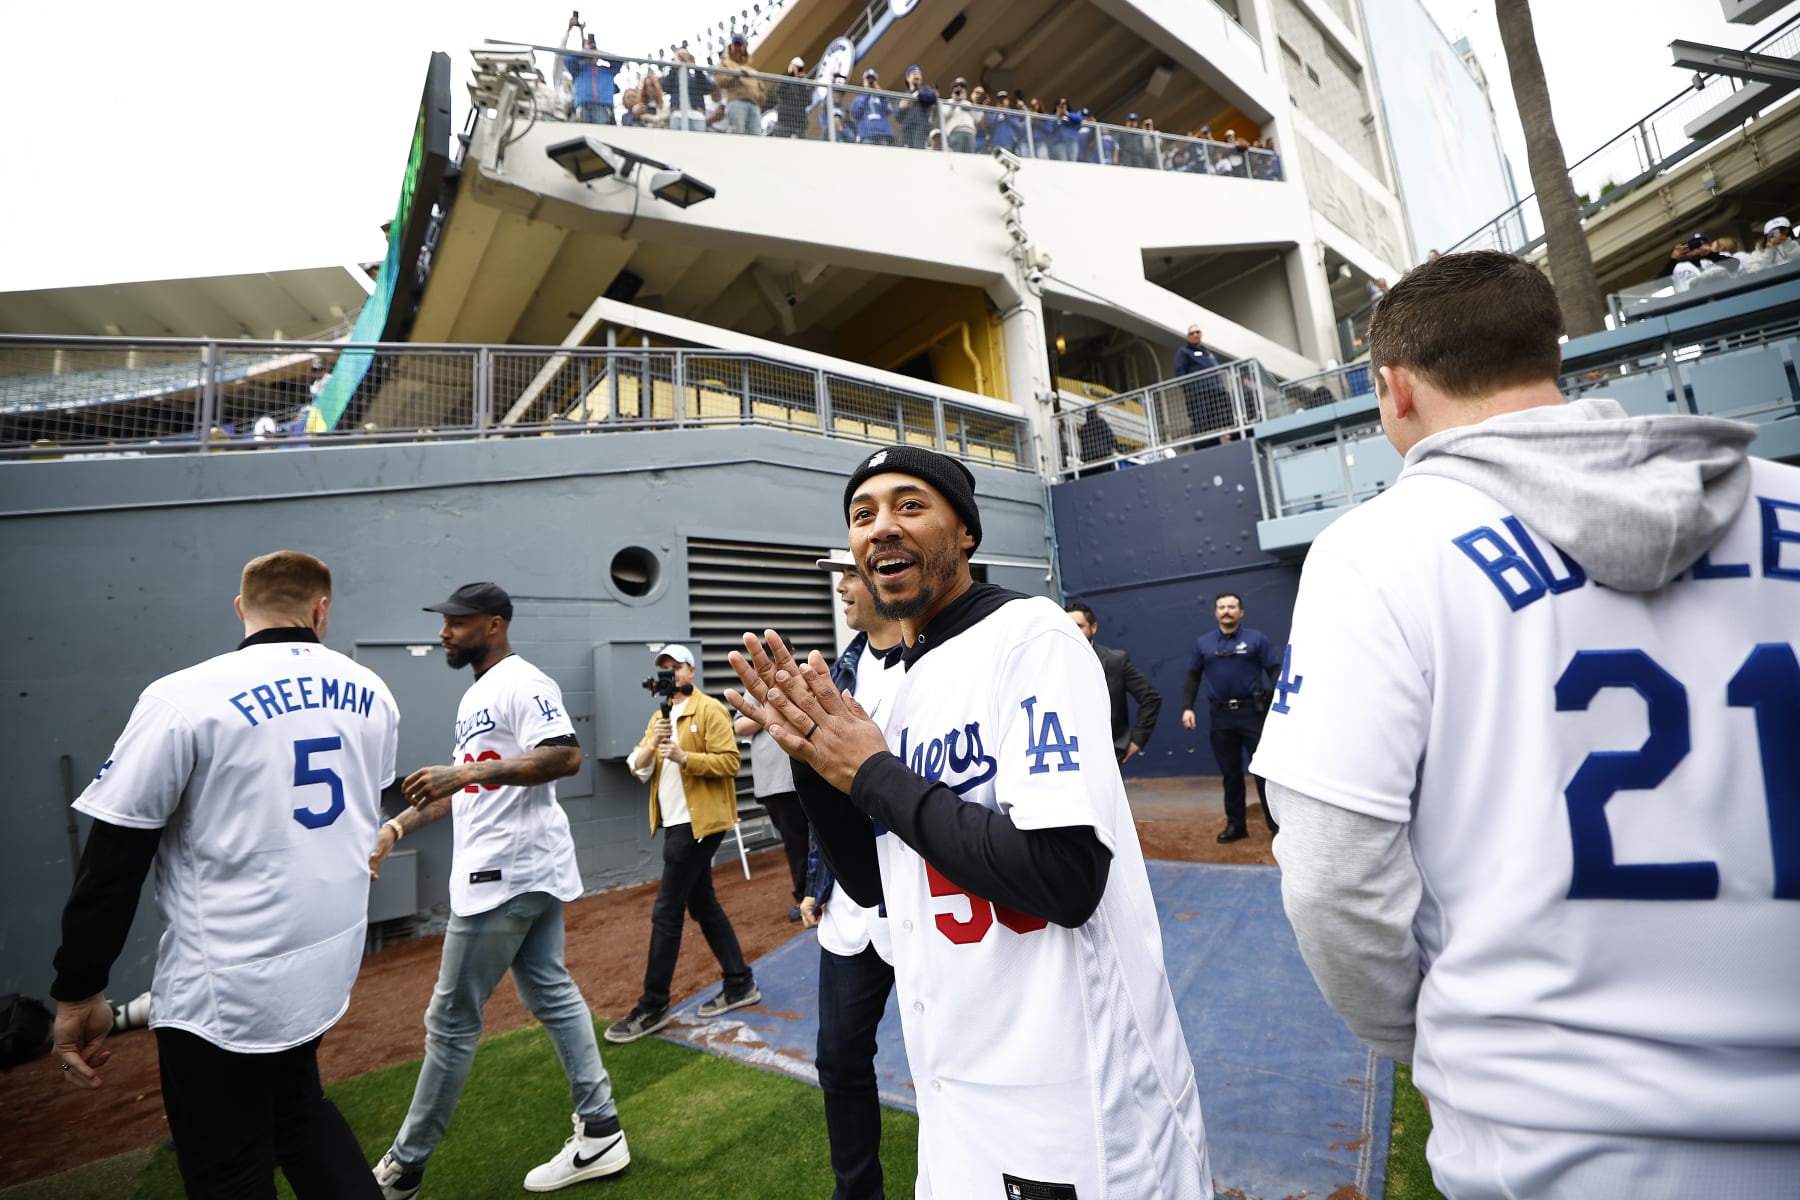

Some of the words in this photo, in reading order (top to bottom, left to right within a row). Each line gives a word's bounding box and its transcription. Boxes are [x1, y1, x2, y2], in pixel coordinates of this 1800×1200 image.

[229, 677, 375, 727] FREEMAN
[532, 695, 562, 722] LA
[1020, 695, 1080, 775] LA
[293, 735, 346, 830] 5
[1554, 642, 1800, 900] 21
